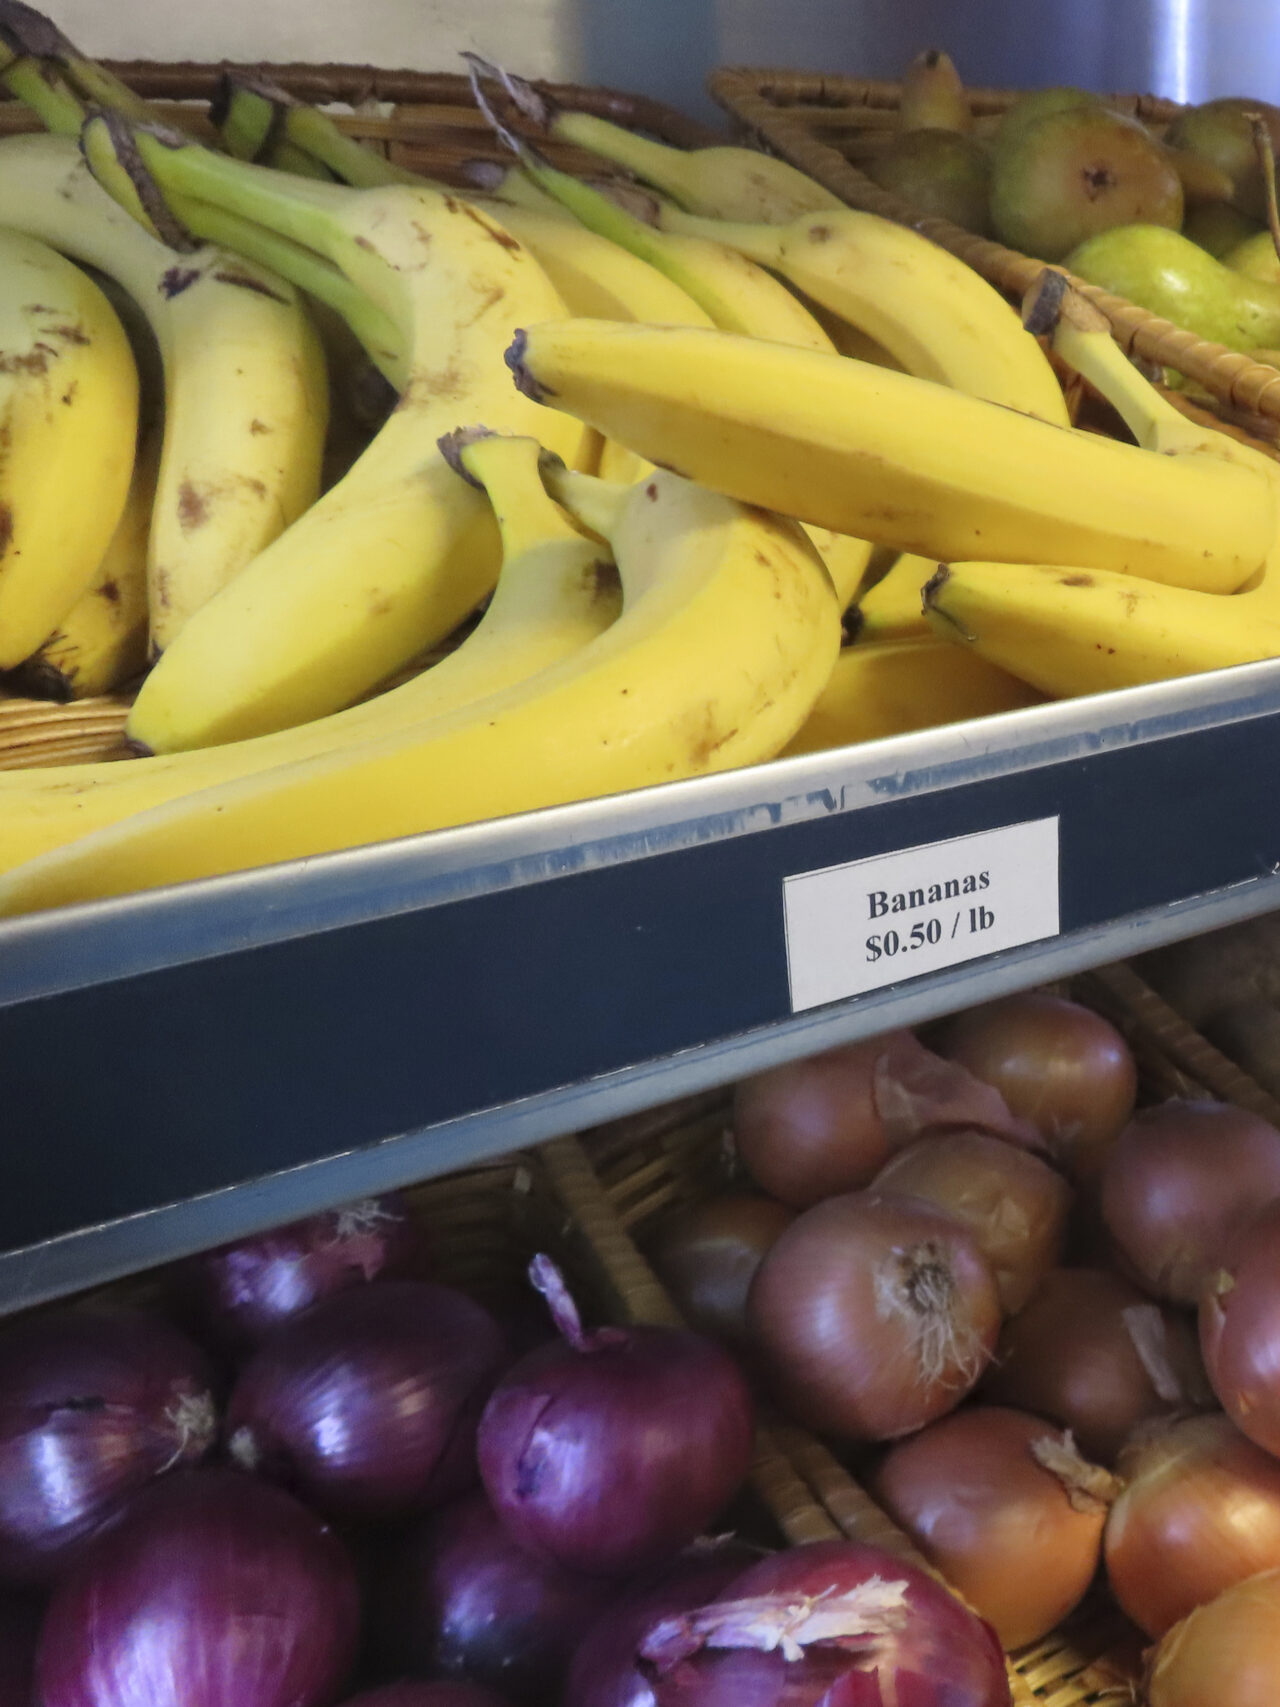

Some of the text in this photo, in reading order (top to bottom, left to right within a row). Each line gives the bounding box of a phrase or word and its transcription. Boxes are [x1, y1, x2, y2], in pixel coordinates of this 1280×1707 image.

[866, 870, 990, 920] Bananas
[866, 905, 995, 962] $0.50 / lb
